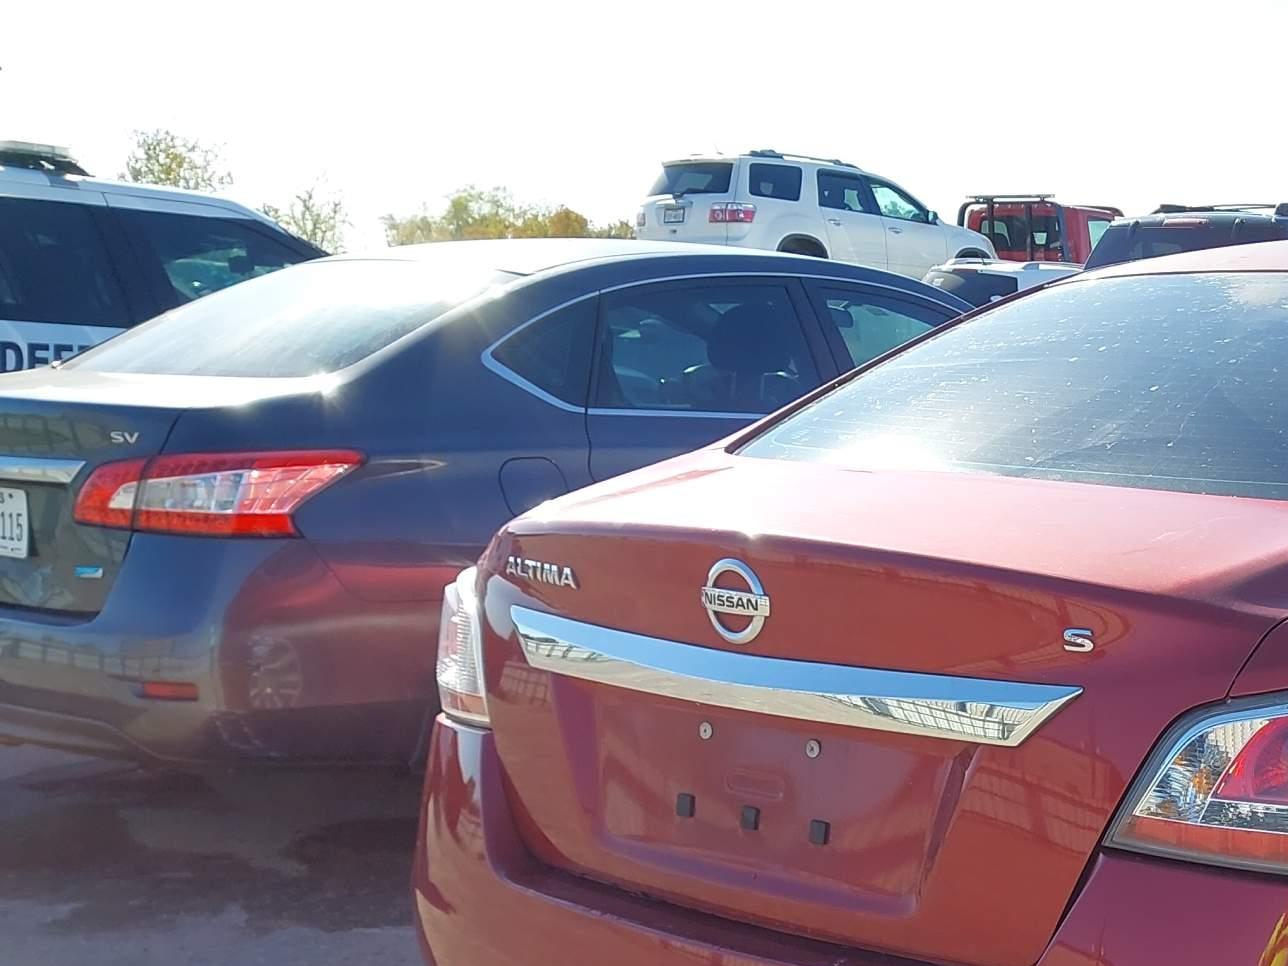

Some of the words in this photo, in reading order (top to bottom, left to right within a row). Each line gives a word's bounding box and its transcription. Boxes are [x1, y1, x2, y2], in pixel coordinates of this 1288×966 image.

[110, 431, 140, 444] SV
[506, 556, 577, 590] ALTIMA
[704, 592, 759, 611] NISSAN
[1063, 628, 1094, 652] S
